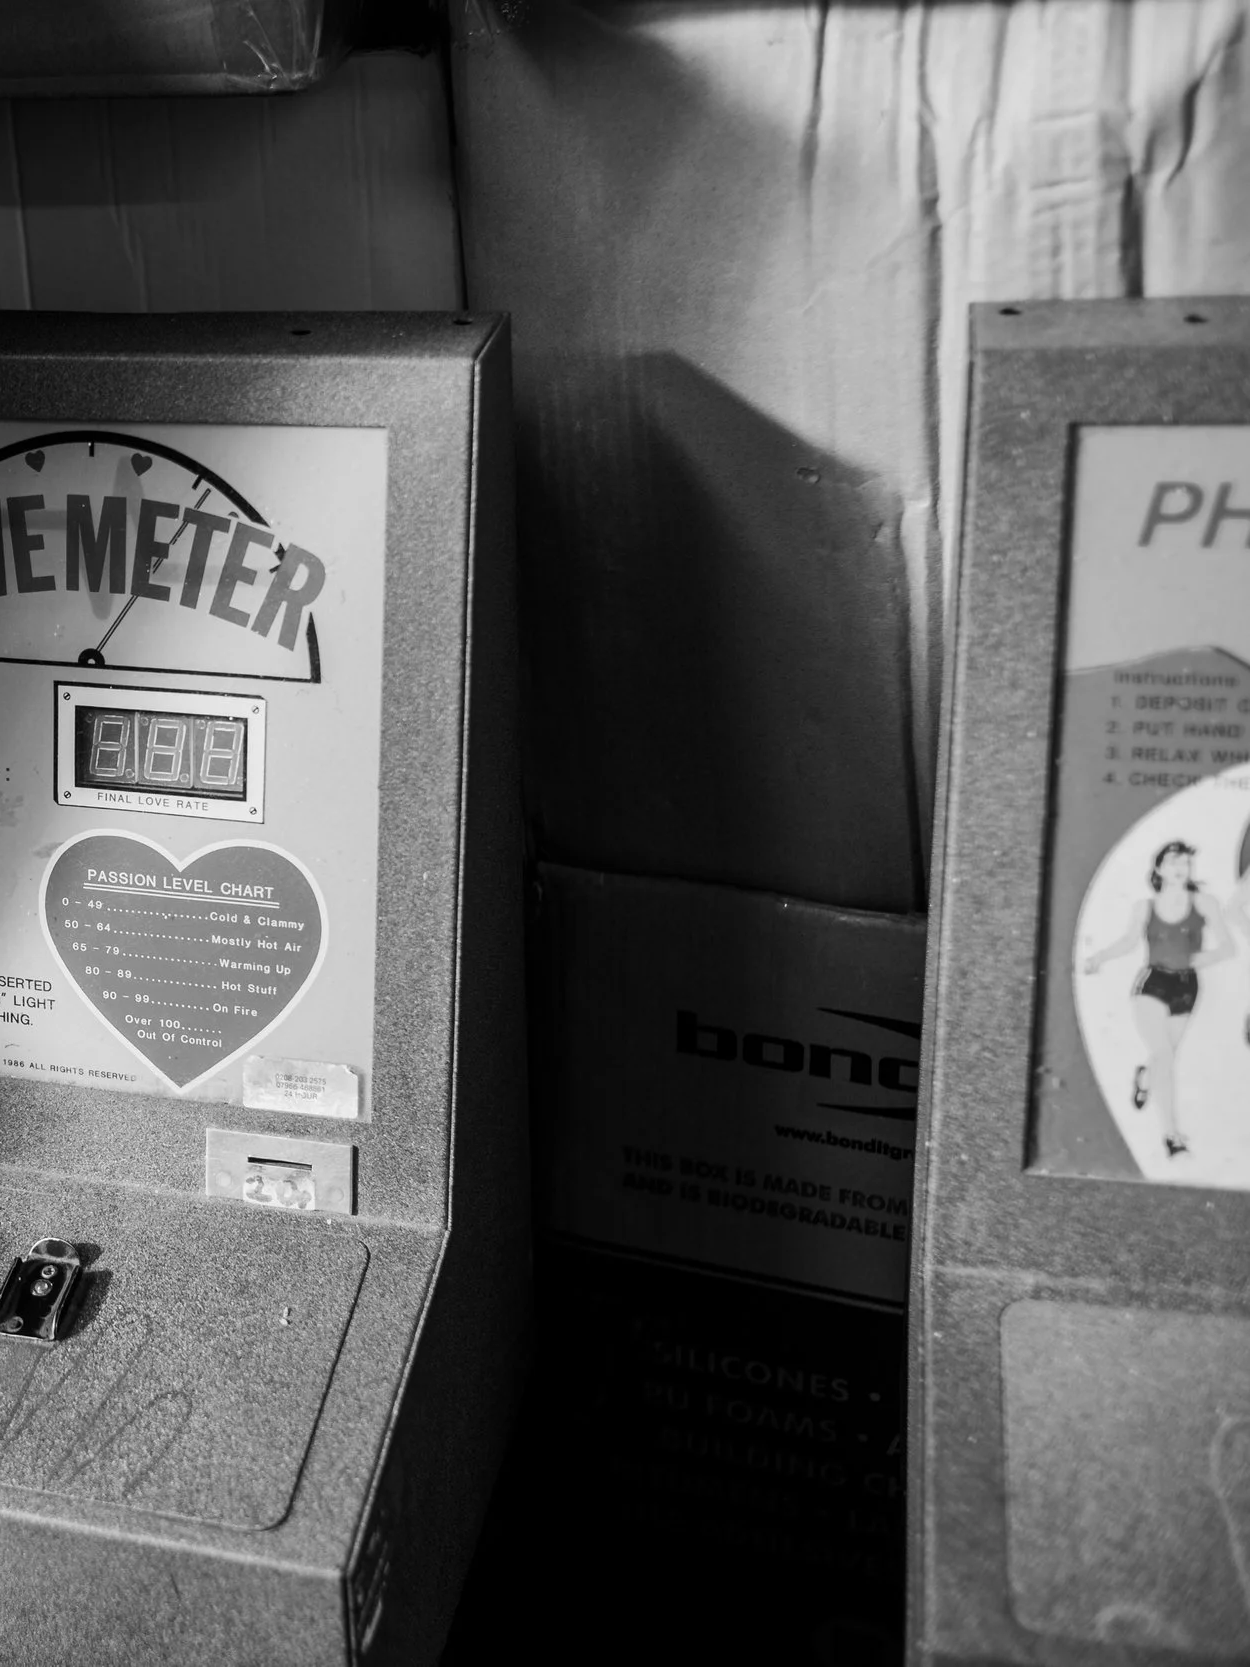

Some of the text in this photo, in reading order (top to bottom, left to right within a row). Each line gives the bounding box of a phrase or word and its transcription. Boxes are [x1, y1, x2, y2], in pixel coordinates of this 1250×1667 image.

[65, 494, 326, 652] METER
[1135, 696, 1227, 711] DEPOSIT
[1133, 721, 1174, 735] PUT
[1183, 724, 1245, 738] HAND
[1131, 746, 1200, 762] RELAX
[1129, 772, 1202, 787] CHECK
[97, 792, 209, 811] FINAL LOVE RATE
[87, 869, 274, 899] PASSION LEVEL CHART
[88, 900, 102, 910] 49
[209, 912, 238, 923] Cold
[243, 915, 251, 924] &
[257, 916, 305, 931] Clammy
[64, 919, 302, 952] 50 64 Mostly Hot Air
[72, 942, 291, 976] 65 79 Warming Up
[85, 966, 277, 996] 80 89 Hot Stuff
[13, 995, 56, 1011] LIGHT
[102, 990, 258, 1017] 90 99 On Fire
[125, 1015, 152, 1026] Over
[137, 1030, 222, 1048] Out Of Control
[2, 1058, 25, 1068] 1986
[29, 1062, 46, 1071] ALL
[50, 1064, 85, 1076] RIGHTS
[621, 1145, 908, 1216] THIS BOX IS MADE FROM
[622, 1172, 906, 1242] AND IS BIODEGRADABLE
